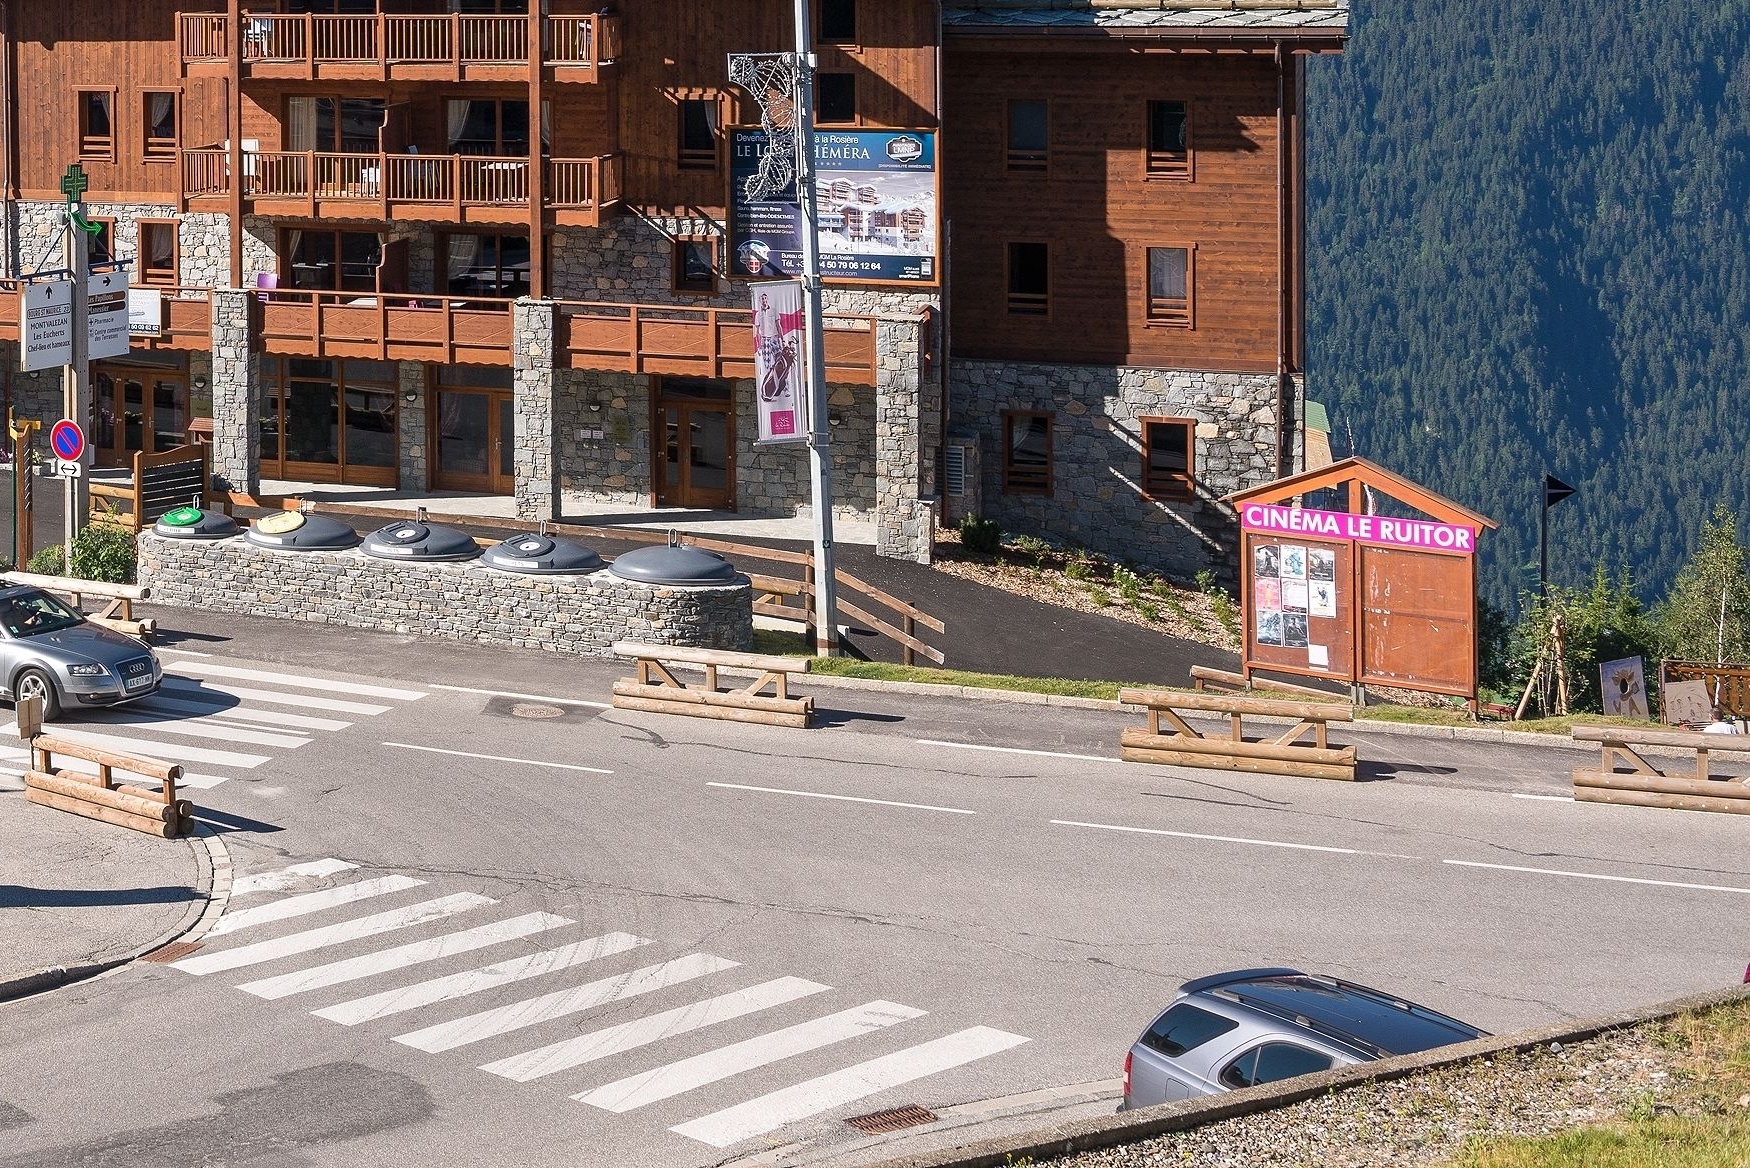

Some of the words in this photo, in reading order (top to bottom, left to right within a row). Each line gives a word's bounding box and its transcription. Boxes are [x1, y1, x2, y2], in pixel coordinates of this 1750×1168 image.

[736, 133, 768, 142] Devenez
[830, 135, 859, 144] Rosière
[737, 145, 751, 157] LE
[826, 261, 836, 269] 50
[838, 261, 848, 269] 79
[861, 262, 870, 270] 12
[870, 262, 881, 270] 64
[30, 317, 68, 330] MONTVALEZAN
[33, 332, 42, 341] Les
[43, 329, 65, 339] Eucherts
[27, 343, 47, 353] Chef-lieu
[51, 340, 70, 349] hameaux
[1246, 505, 1341, 536] CINÉMA
[1347, 516, 1372, 538] LE
[1380, 522, 1471, 550] RUITOR
